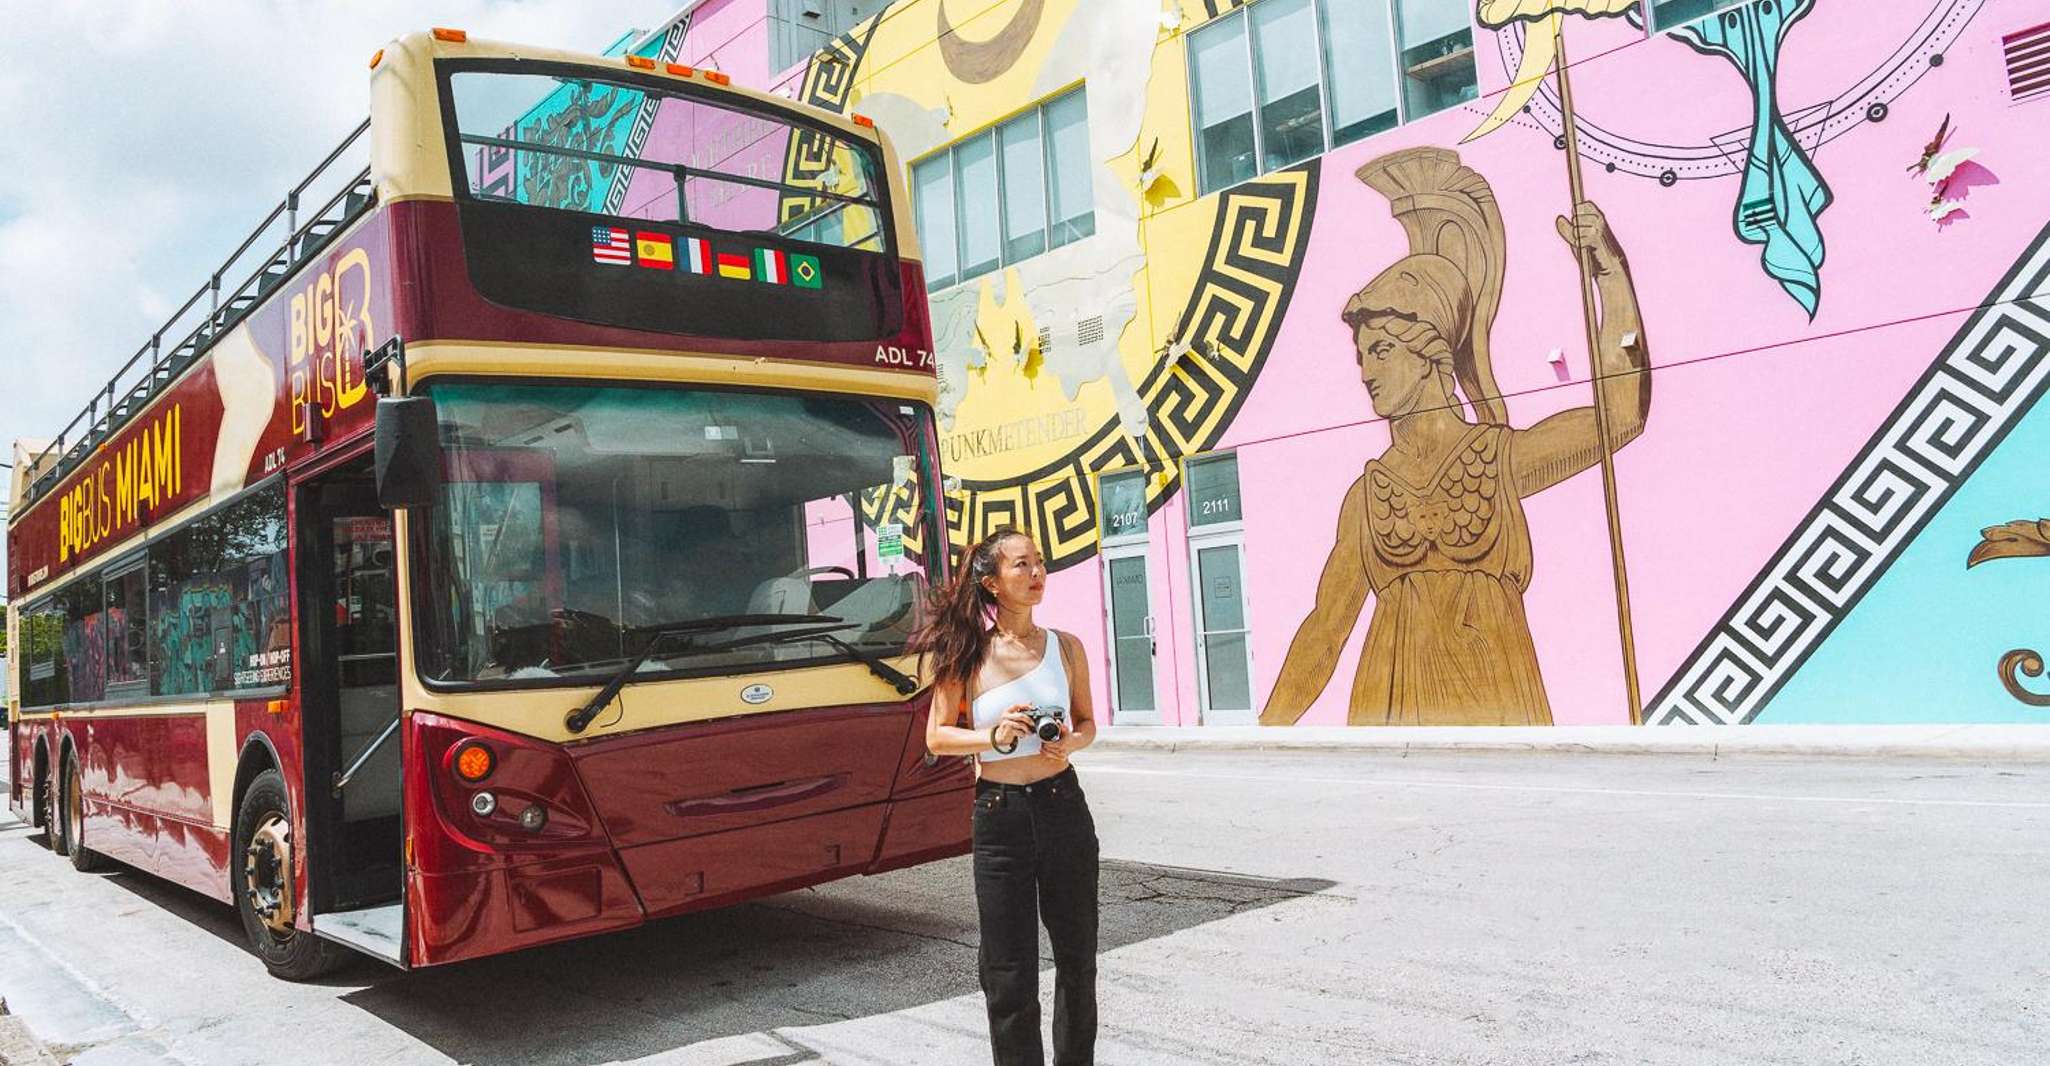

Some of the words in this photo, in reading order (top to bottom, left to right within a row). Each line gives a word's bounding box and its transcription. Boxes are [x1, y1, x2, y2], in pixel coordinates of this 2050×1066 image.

[291, 272, 334, 366] BIG
[875, 344, 913, 366] ADL
[917, 350, 936, 369] 74
[291, 351, 336, 435] BUS
[116, 402, 182, 529] MIAMI
[264, 452, 277, 473] ADL
[1203, 499, 1229, 514] 2111
[1112, 512, 1138, 527] 2107
